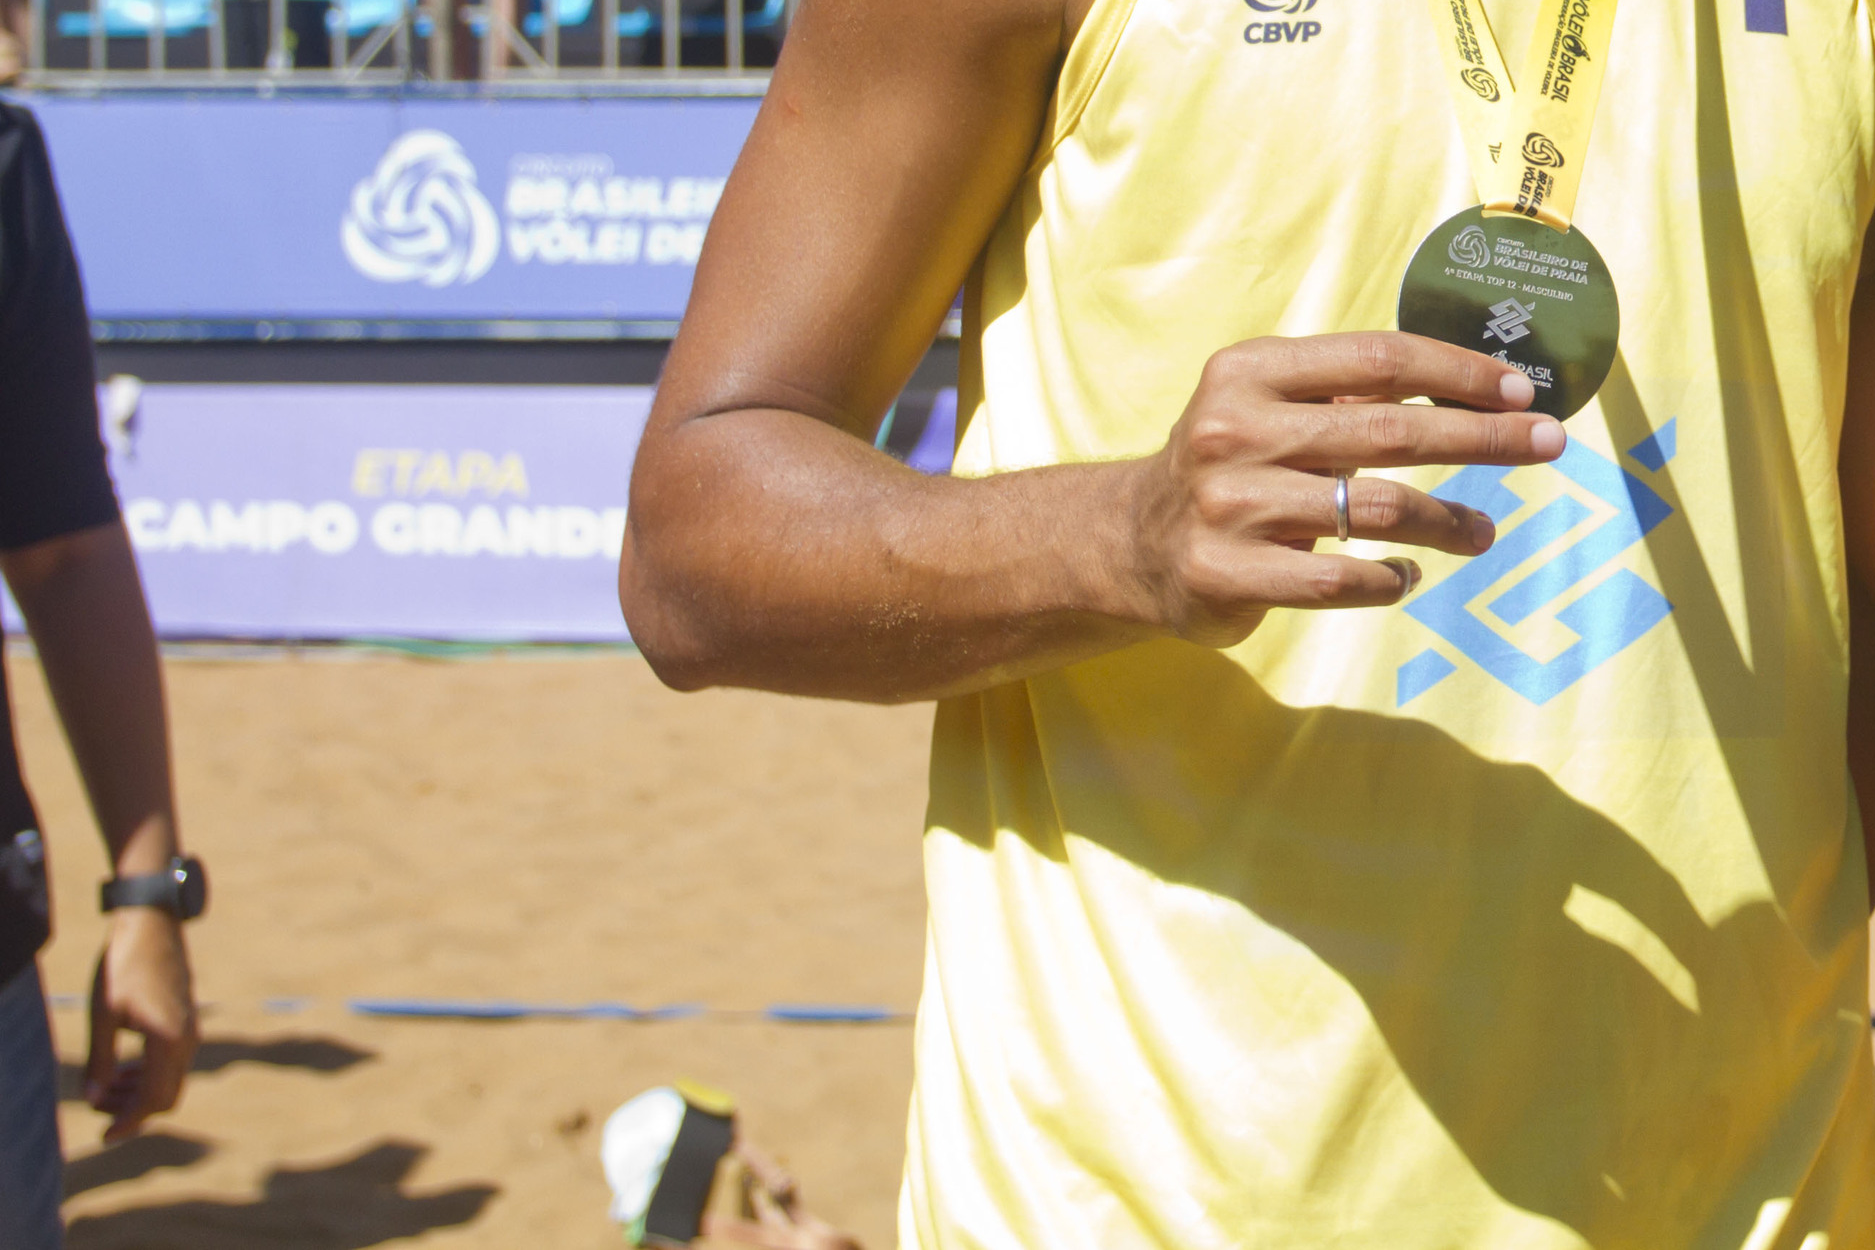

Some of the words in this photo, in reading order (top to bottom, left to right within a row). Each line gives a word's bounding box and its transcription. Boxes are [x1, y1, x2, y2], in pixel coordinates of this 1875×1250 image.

[1243, 20, 1322, 44] CBVP
[1551, 51, 1576, 103] BRASIL
[1520, 166, 1536, 195] VÔLEI
[508, 213, 642, 265] VÔLEI
[1493, 255, 1529, 272] VÔLEI
[1531, 264, 1549, 276] DE
[1549, 268, 1588, 285] PRAIA
[1495, 244, 1569, 268] BRASILEIRO
[1570, 260, 1589, 272] DE
[1456, 269, 1485, 283] ETAPA
[1487, 275, 1505, 287] TOP
[1507, 280, 1516, 289] 12
[1521, 283, 1574, 301] MASCULINO
[351, 448, 529, 499] ETAPA
[125, 497, 360, 555] CAMPO
